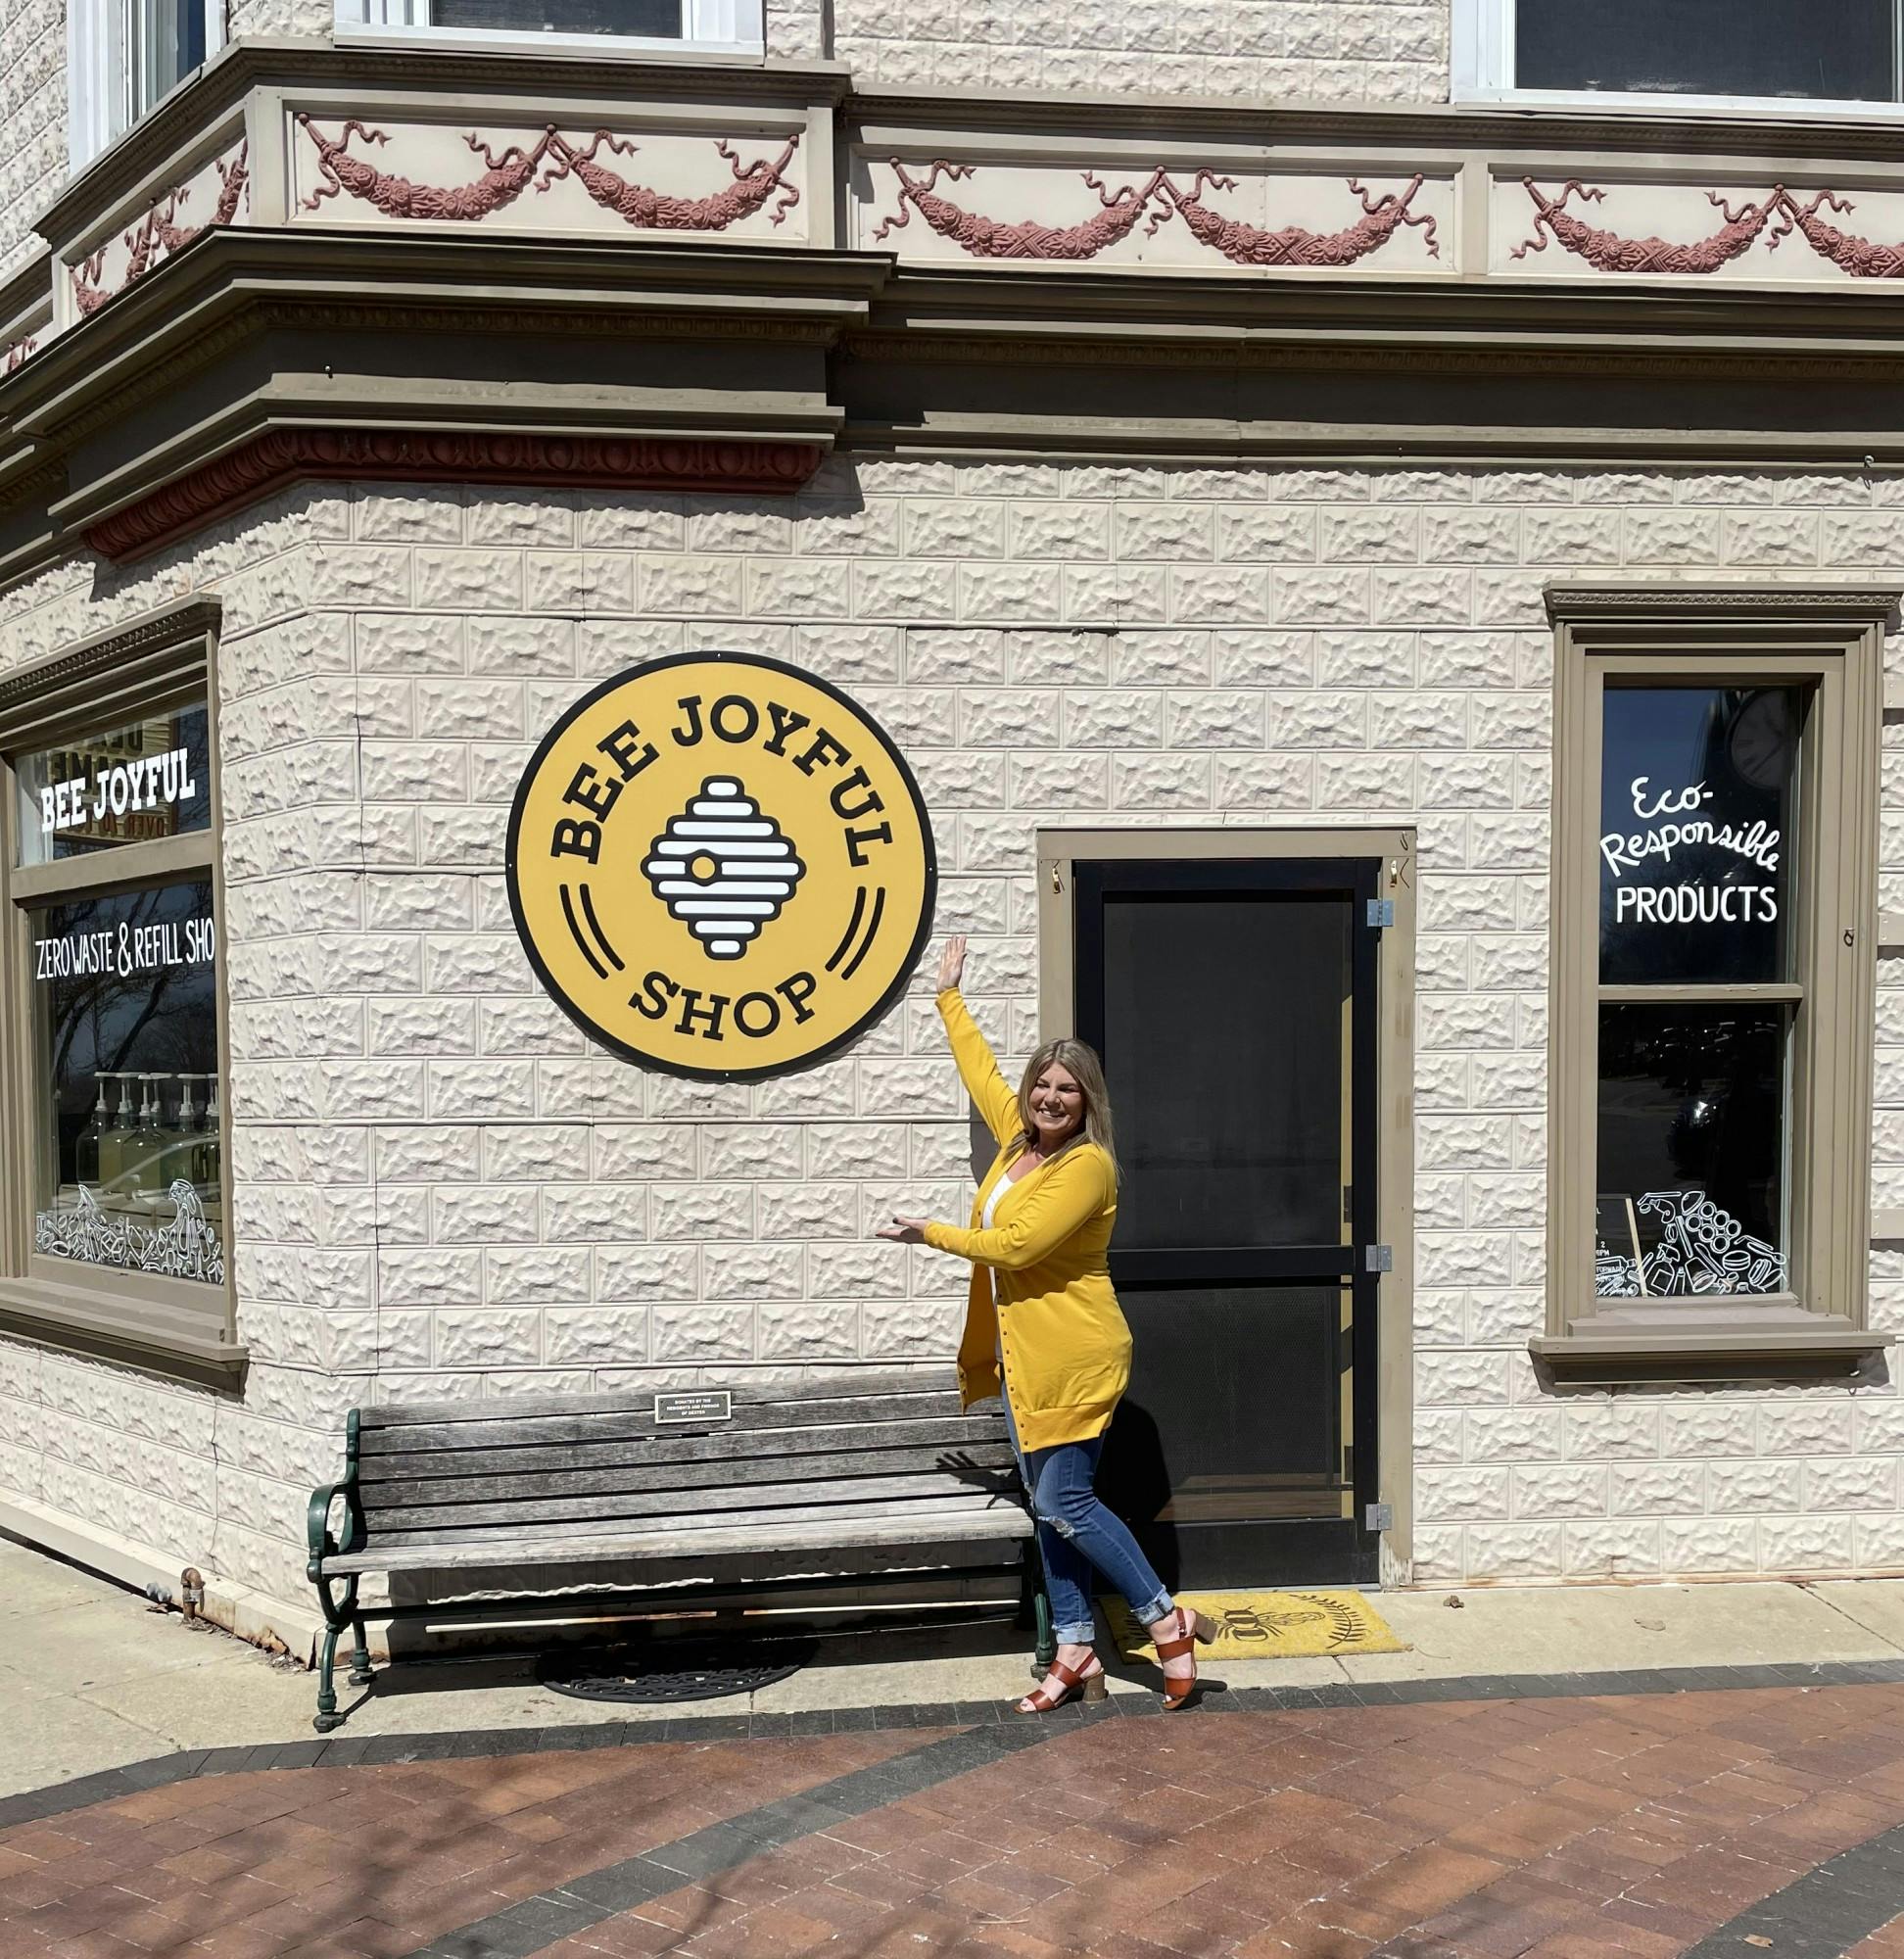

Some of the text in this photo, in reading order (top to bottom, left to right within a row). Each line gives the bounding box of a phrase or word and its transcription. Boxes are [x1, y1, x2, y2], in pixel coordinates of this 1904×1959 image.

[41, 777, 87, 833] BEE
[93, 747, 196, 820] JOYFUL
[550, 694, 893, 868] BEE JOYFUL
[1631, 777, 1713, 819] Eco-
[1599, 820, 1780, 878] Responsible
[1616, 885, 1778, 924] PRODUCTS
[34, 917, 215, 980] ZERO WASTE & REFILL SHO
[628, 971, 817, 1041] SHOP
